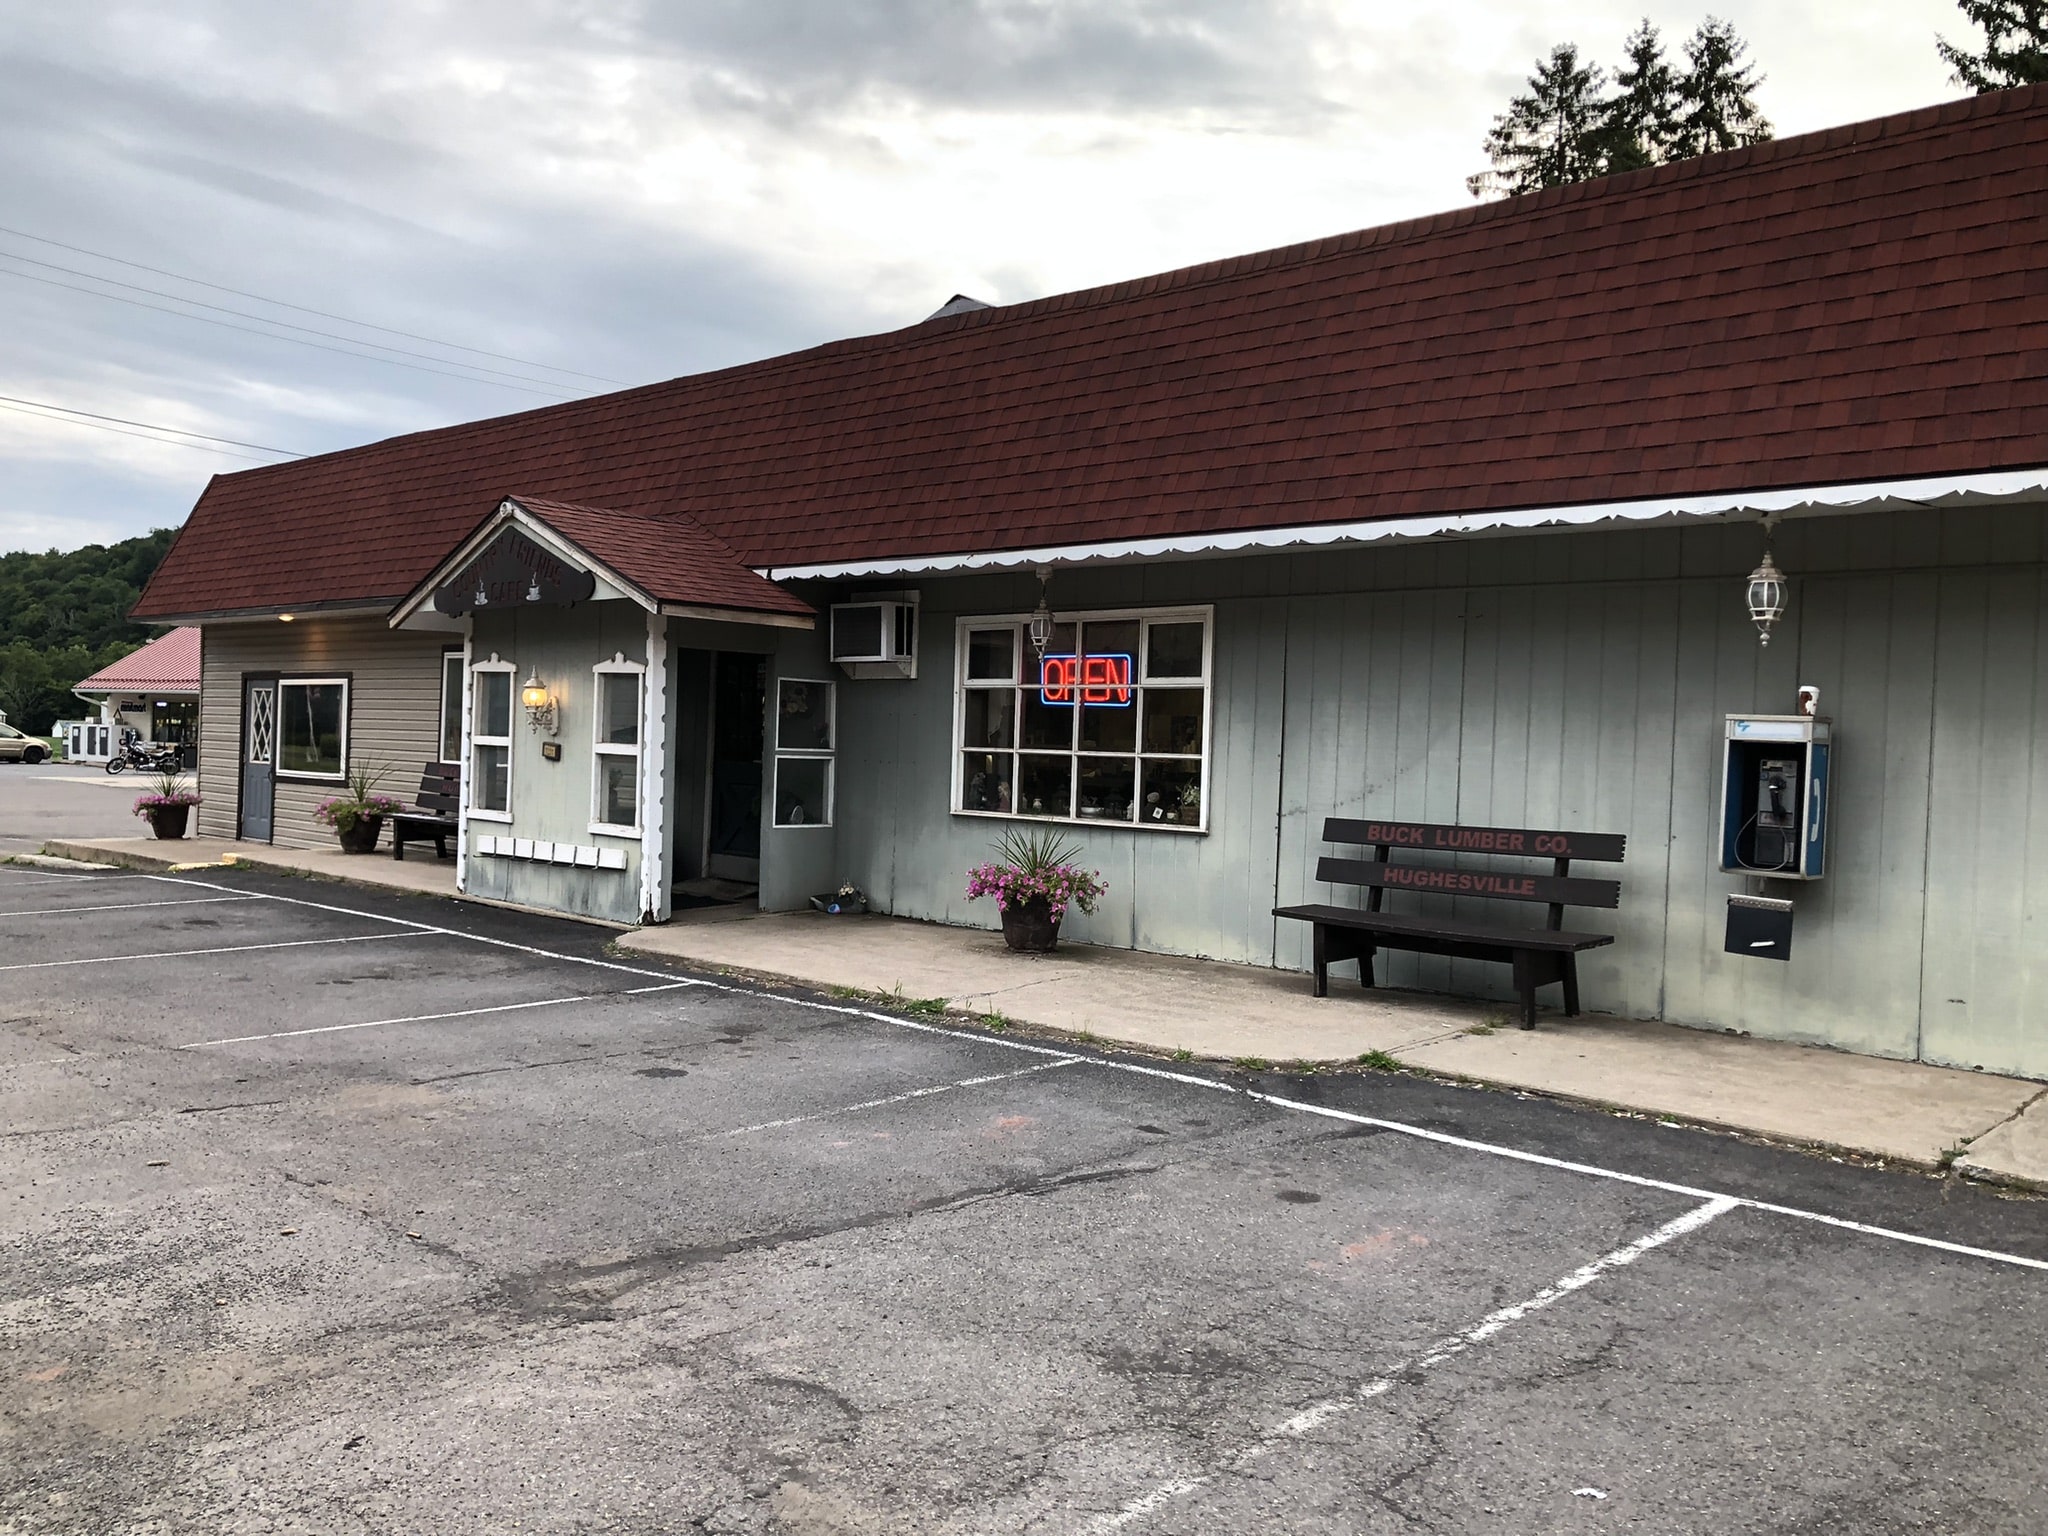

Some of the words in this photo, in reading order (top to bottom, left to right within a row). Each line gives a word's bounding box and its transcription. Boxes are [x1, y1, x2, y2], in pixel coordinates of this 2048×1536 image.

[452, 536, 504, 598] COUNTRY
[490, 580, 525, 602] CAFE
[1044, 658, 1128, 702] OPEN
[1366, 824, 1424, 844] BUCK
[1435, 829, 1525, 851] LUMBER
[1535, 835, 1572, 854] CO.
[1383, 867, 1536, 896] HUGHESVILLE
